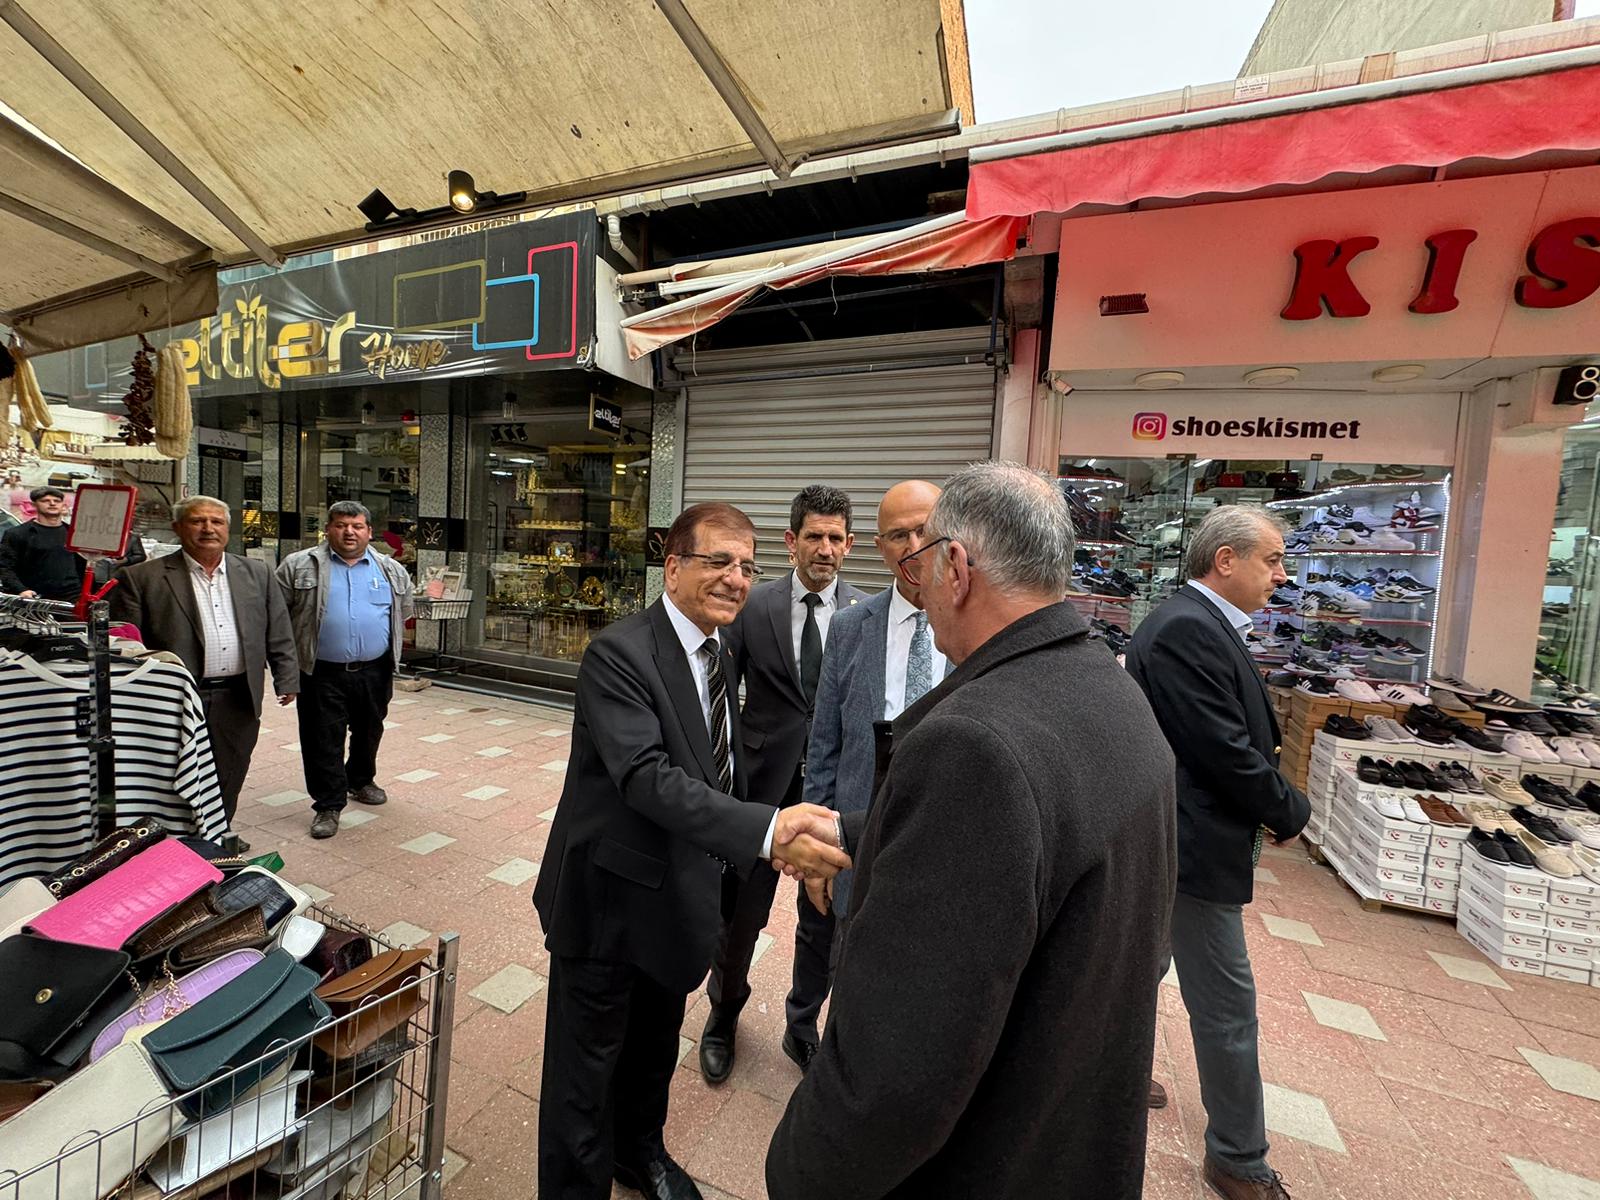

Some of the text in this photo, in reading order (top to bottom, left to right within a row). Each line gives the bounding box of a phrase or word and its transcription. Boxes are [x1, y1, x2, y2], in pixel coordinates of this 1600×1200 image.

[1279, 217, 1600, 320] KIS
[360, 331, 450, 380] Home
[1171, 416, 1361, 439] shoeskismet
